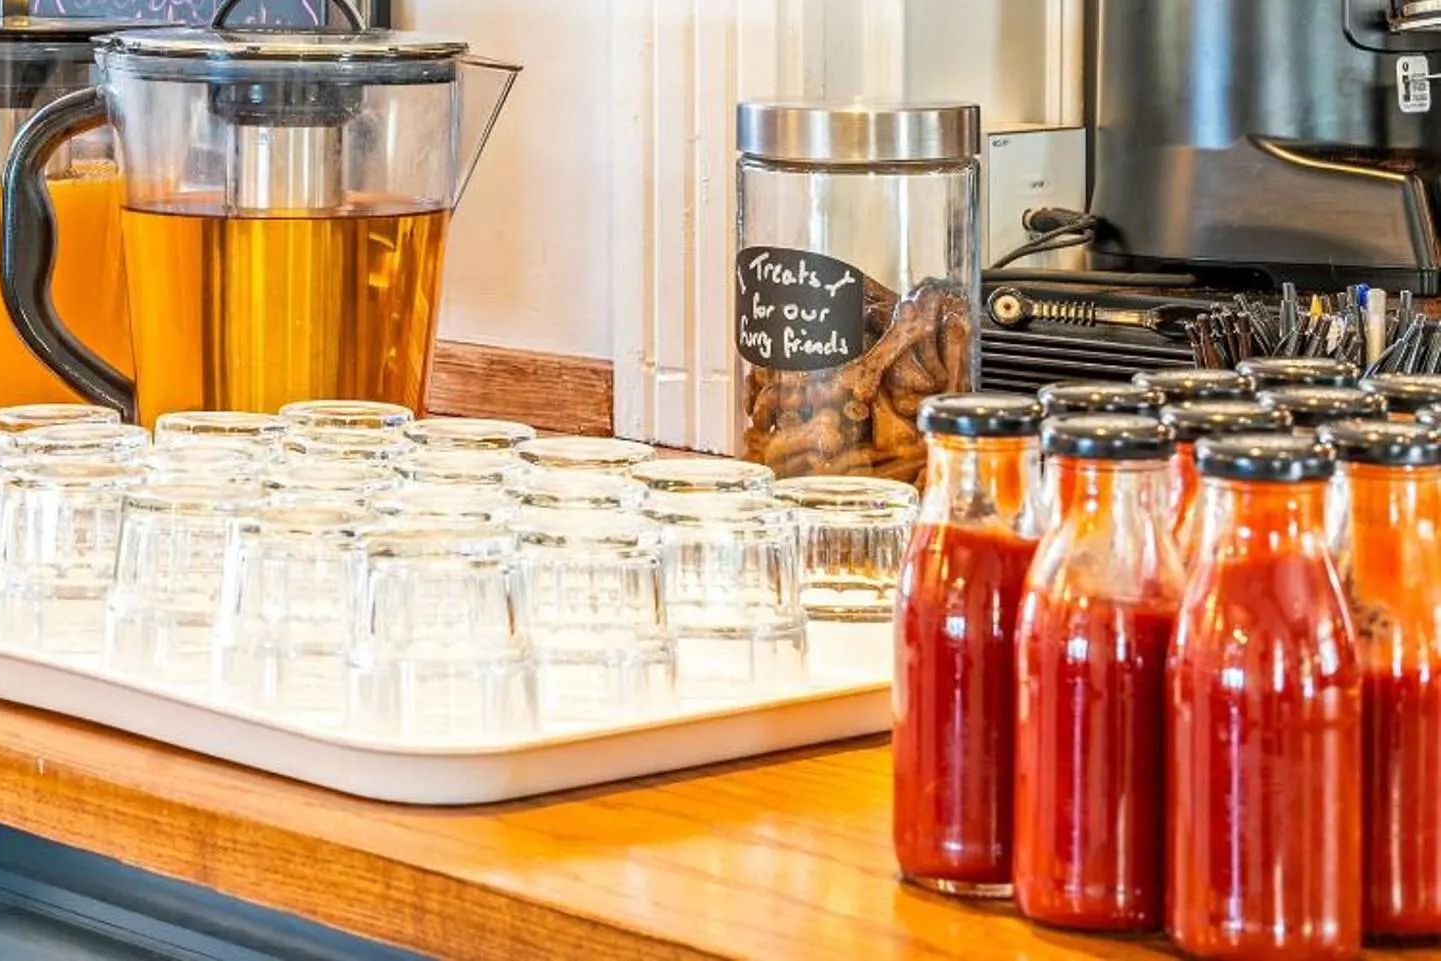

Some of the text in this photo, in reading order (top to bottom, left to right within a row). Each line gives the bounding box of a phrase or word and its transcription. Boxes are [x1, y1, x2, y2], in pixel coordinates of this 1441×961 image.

[748, 251, 821, 288] Treats
[753, 291, 830, 323] for our
[783, 326, 849, 359] friends
